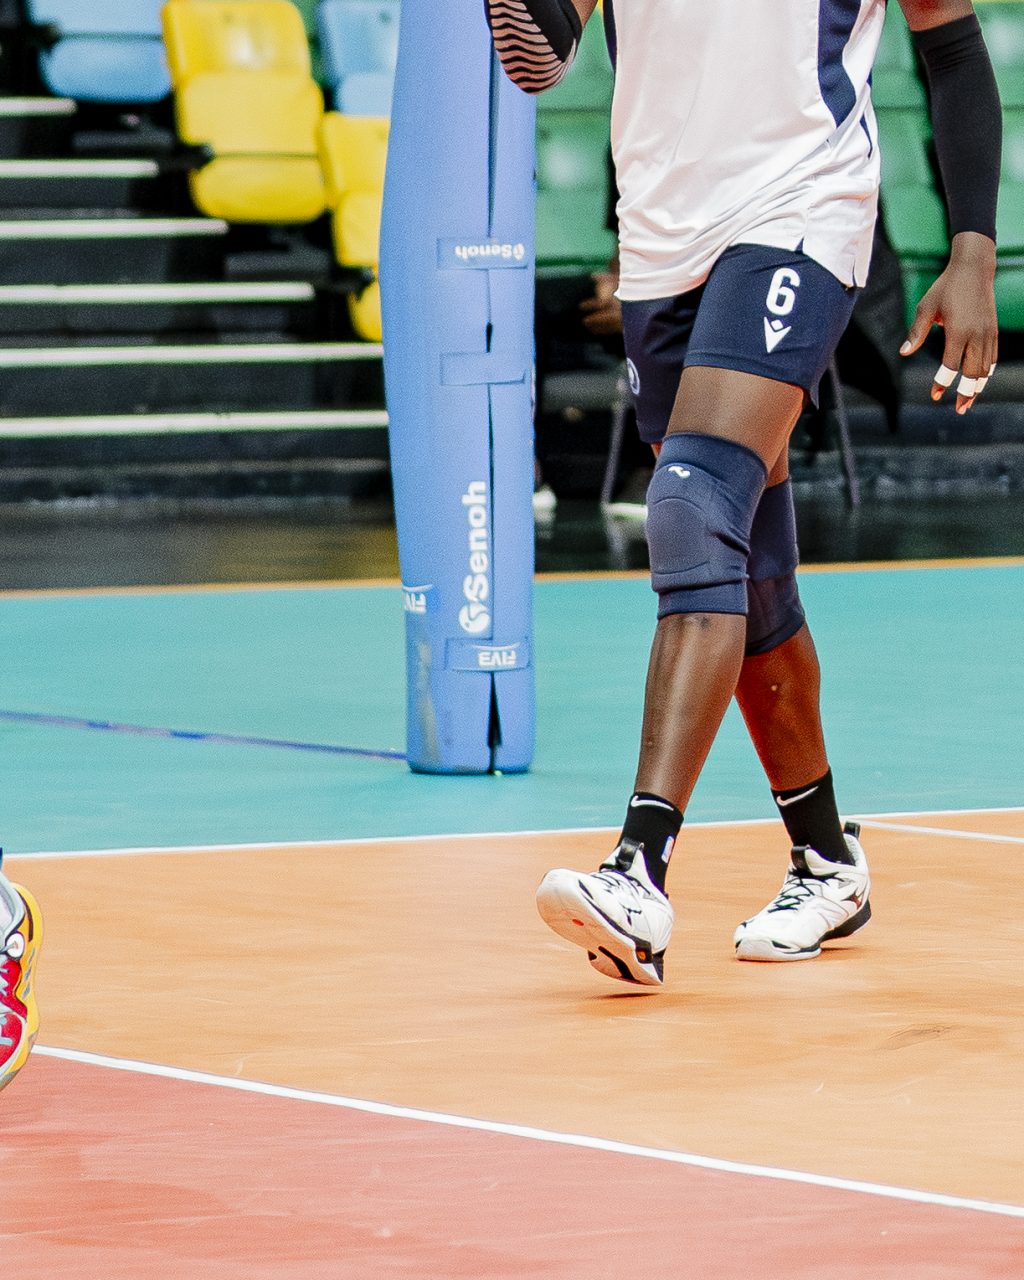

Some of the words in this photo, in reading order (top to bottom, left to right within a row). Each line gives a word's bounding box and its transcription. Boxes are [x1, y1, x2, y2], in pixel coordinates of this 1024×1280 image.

[454, 243, 513, 260] Senoh
[766, 267, 801, 317] 6
[461, 480, 489, 601] Senoh
